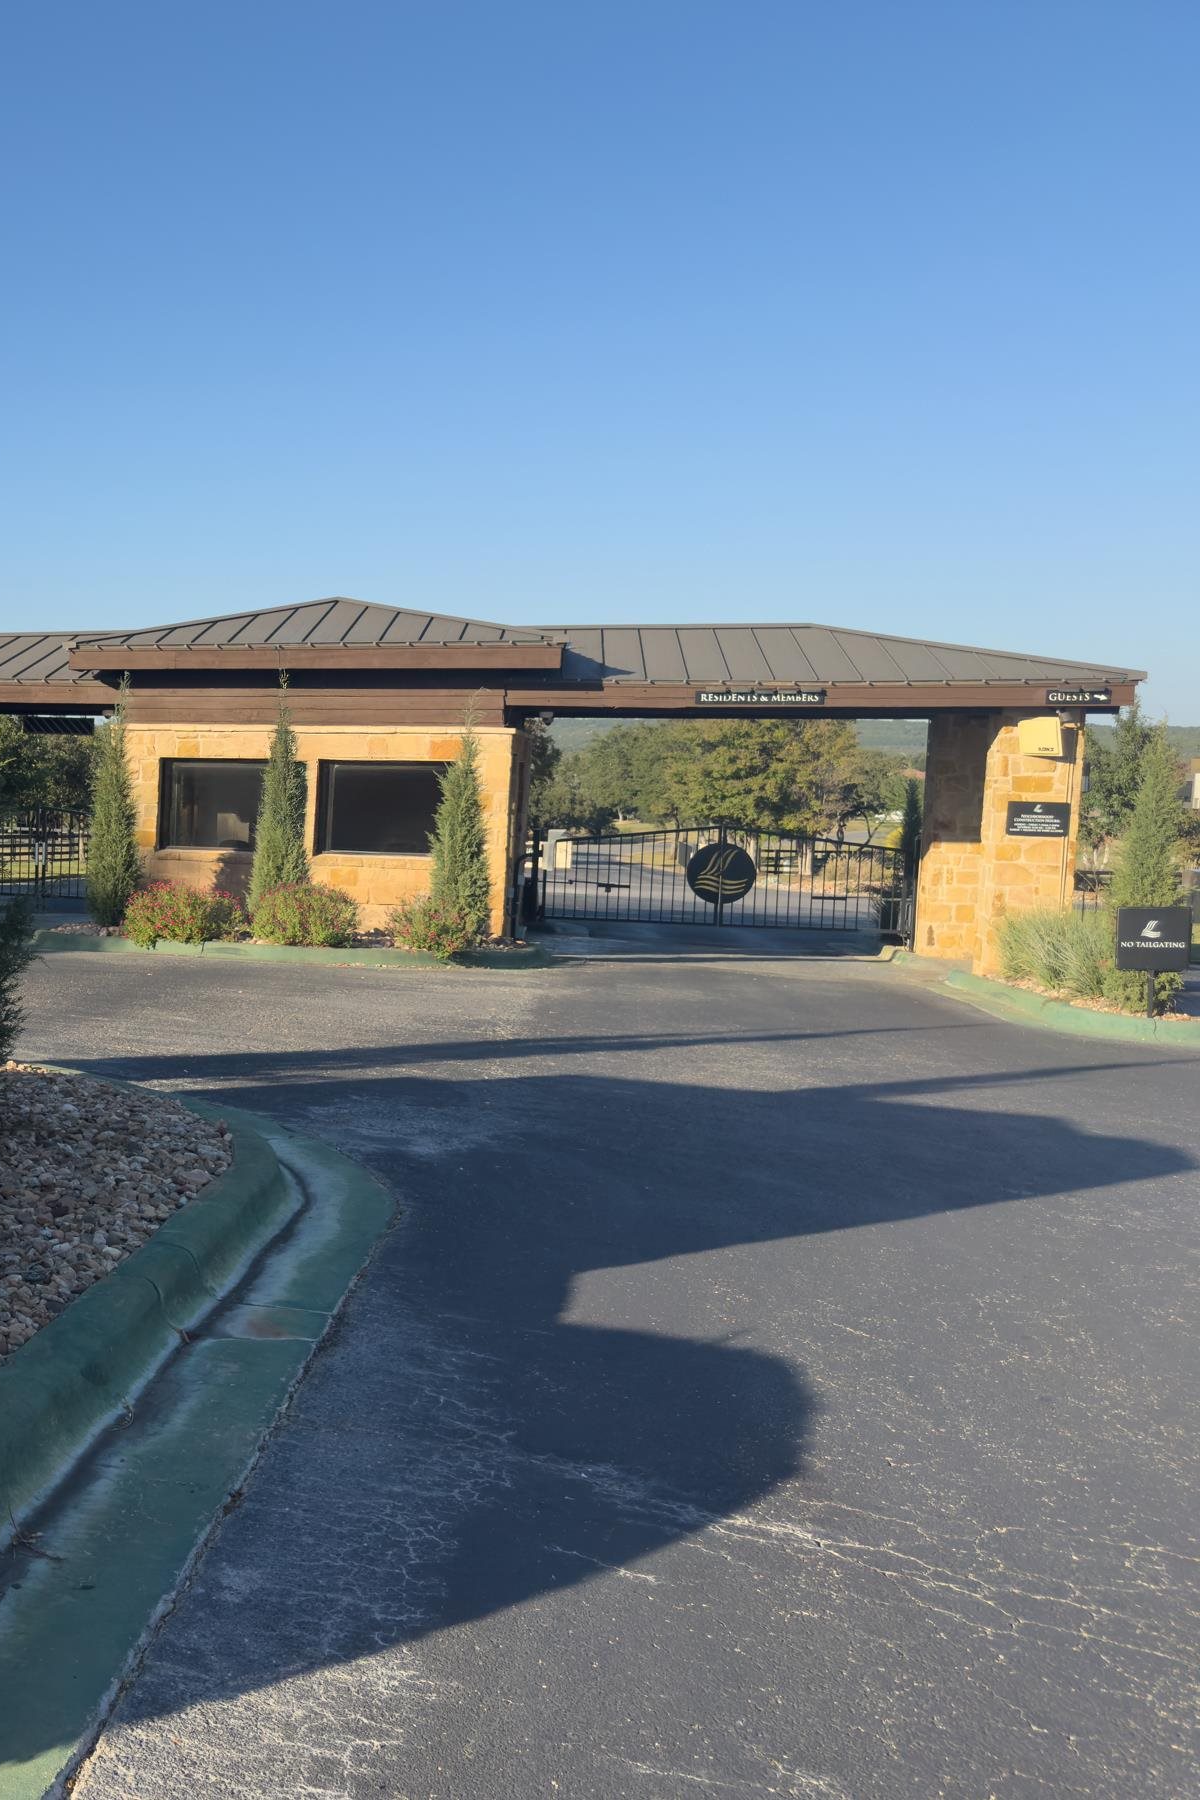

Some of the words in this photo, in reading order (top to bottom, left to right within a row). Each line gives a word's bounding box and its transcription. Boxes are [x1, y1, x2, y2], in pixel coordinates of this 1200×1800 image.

[700, 693, 757, 702] RESIDENTS
[760, 694, 768, 702] &
[771, 693, 819, 702] MEMBERS
[1048, 692, 1090, 702] GUESTS
